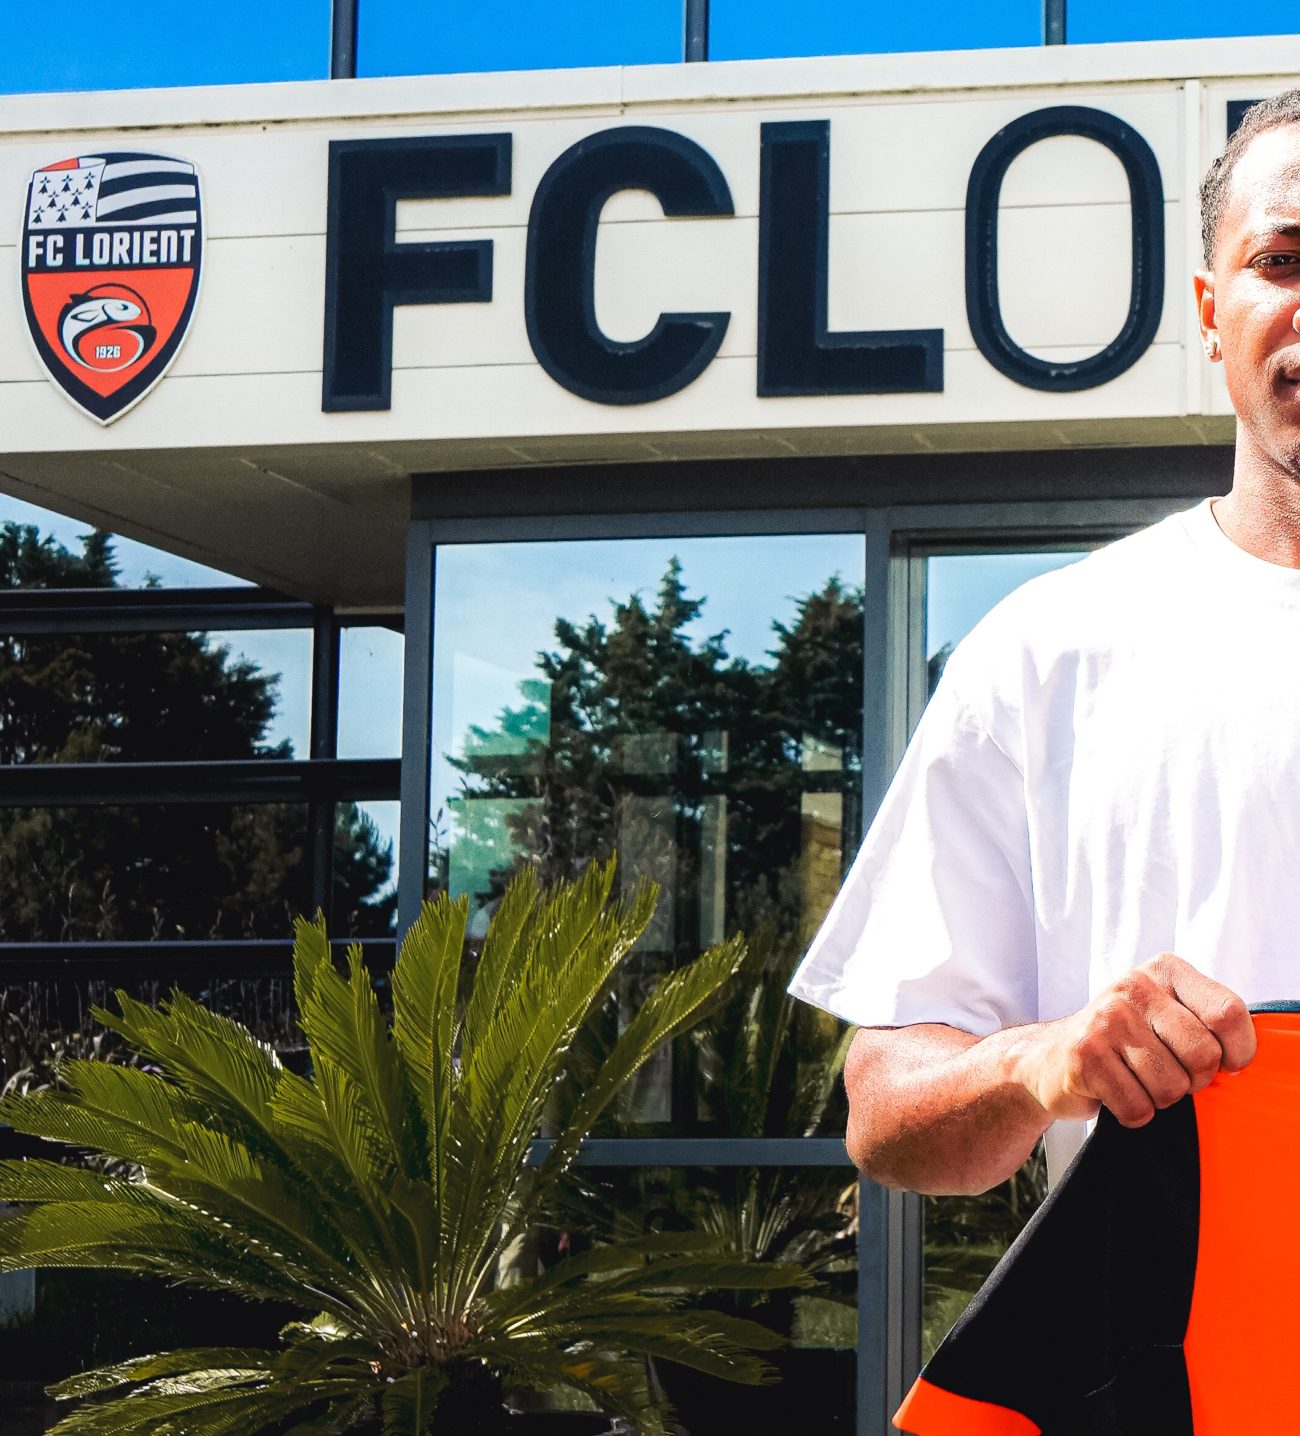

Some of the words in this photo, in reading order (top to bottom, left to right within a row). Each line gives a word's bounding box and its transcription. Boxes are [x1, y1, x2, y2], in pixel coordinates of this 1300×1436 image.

[28, 234, 64, 268] FC
[75, 229, 196, 266] LORIENT
[95, 345, 121, 359] 1926
